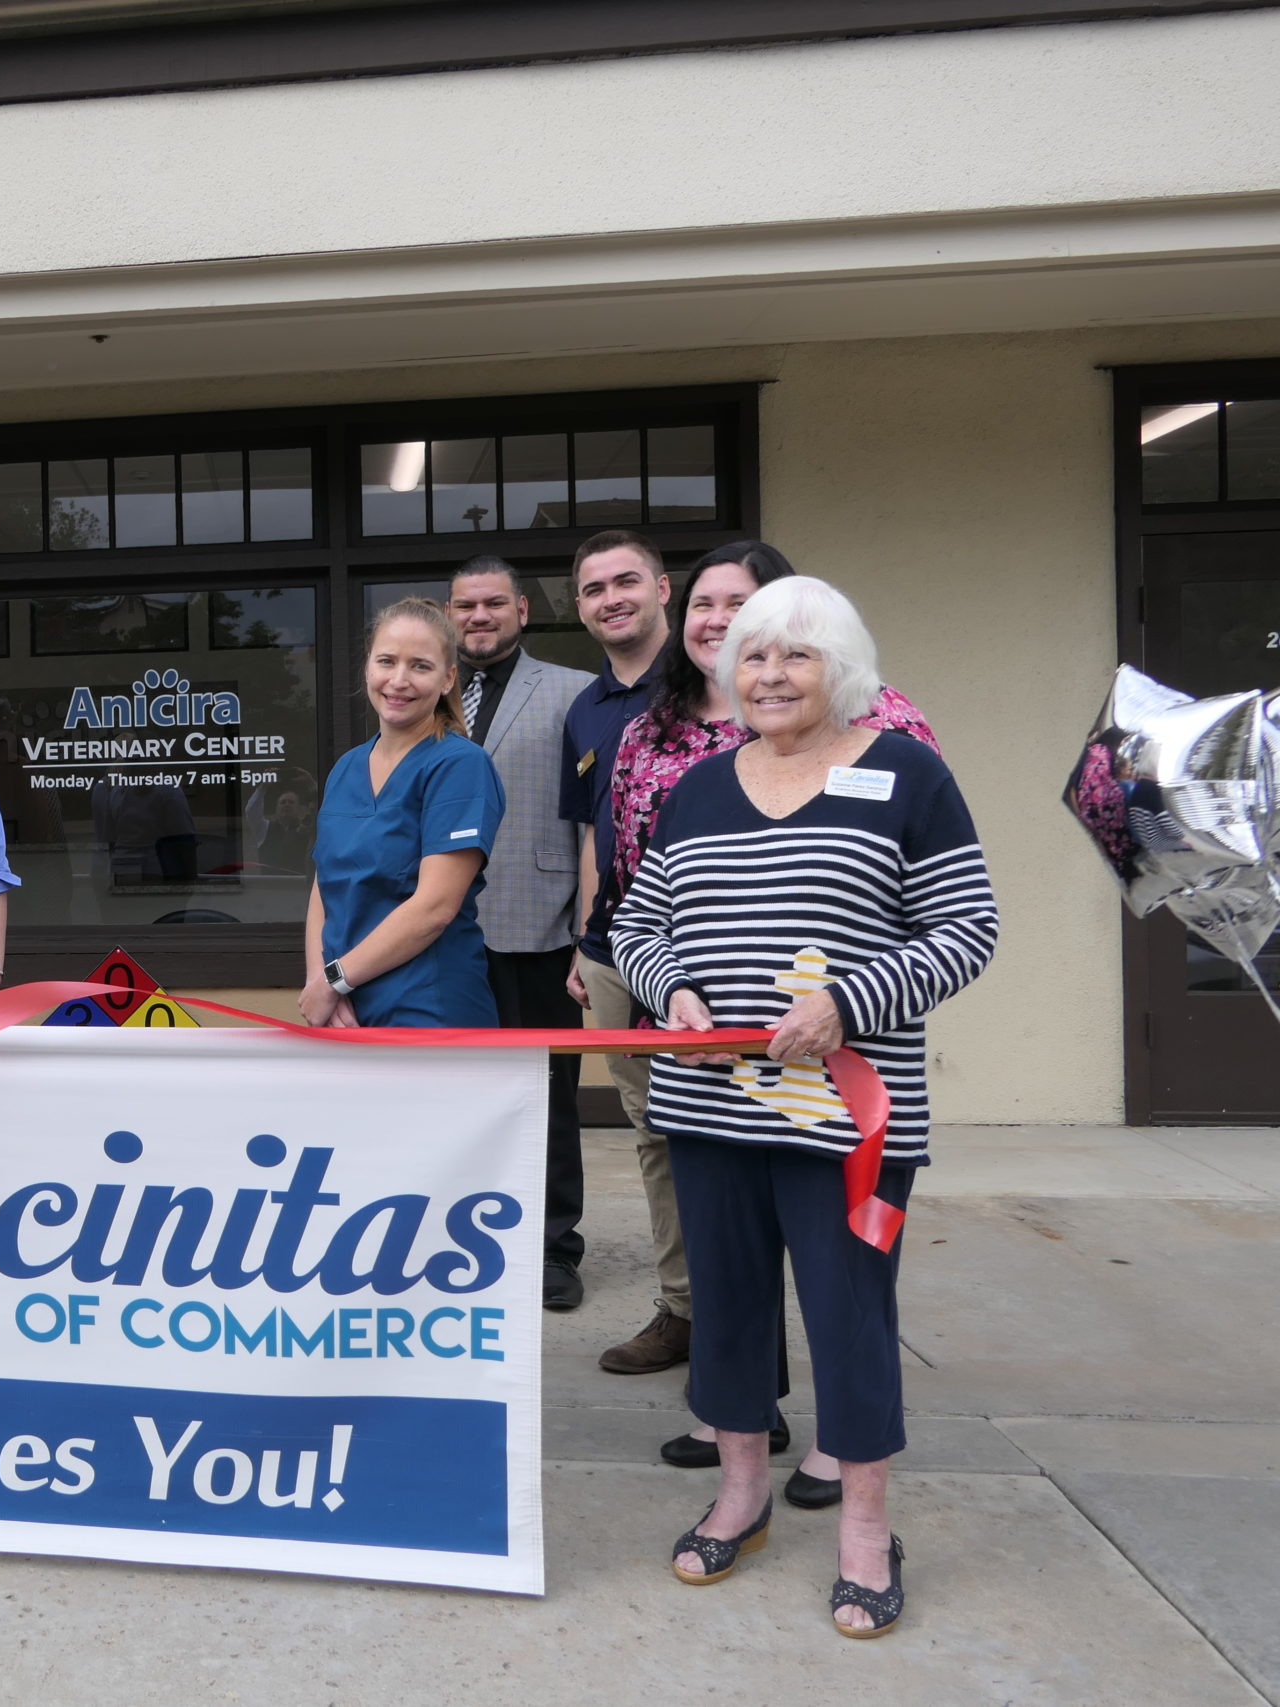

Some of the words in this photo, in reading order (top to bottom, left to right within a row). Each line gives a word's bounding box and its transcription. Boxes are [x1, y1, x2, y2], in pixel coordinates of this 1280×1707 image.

[1266, 631, 1280, 649] 2
[63, 680, 241, 729] Anicira
[22, 736, 177, 762] VETERINARY
[183, 732, 286, 757] CENTER
[30, 774, 95, 790] Monday
[107, 771, 182, 789] Thursday
[186, 771, 197, 785] 7
[200, 773, 226, 785] am
[240, 769, 278, 787] 5pm
[104, 962, 135, 1010] 0
[15, 1291, 101, 1346] OF
[120, 1297, 507, 1362] COMMERCE
[133, 1416, 354, 1513] You!
